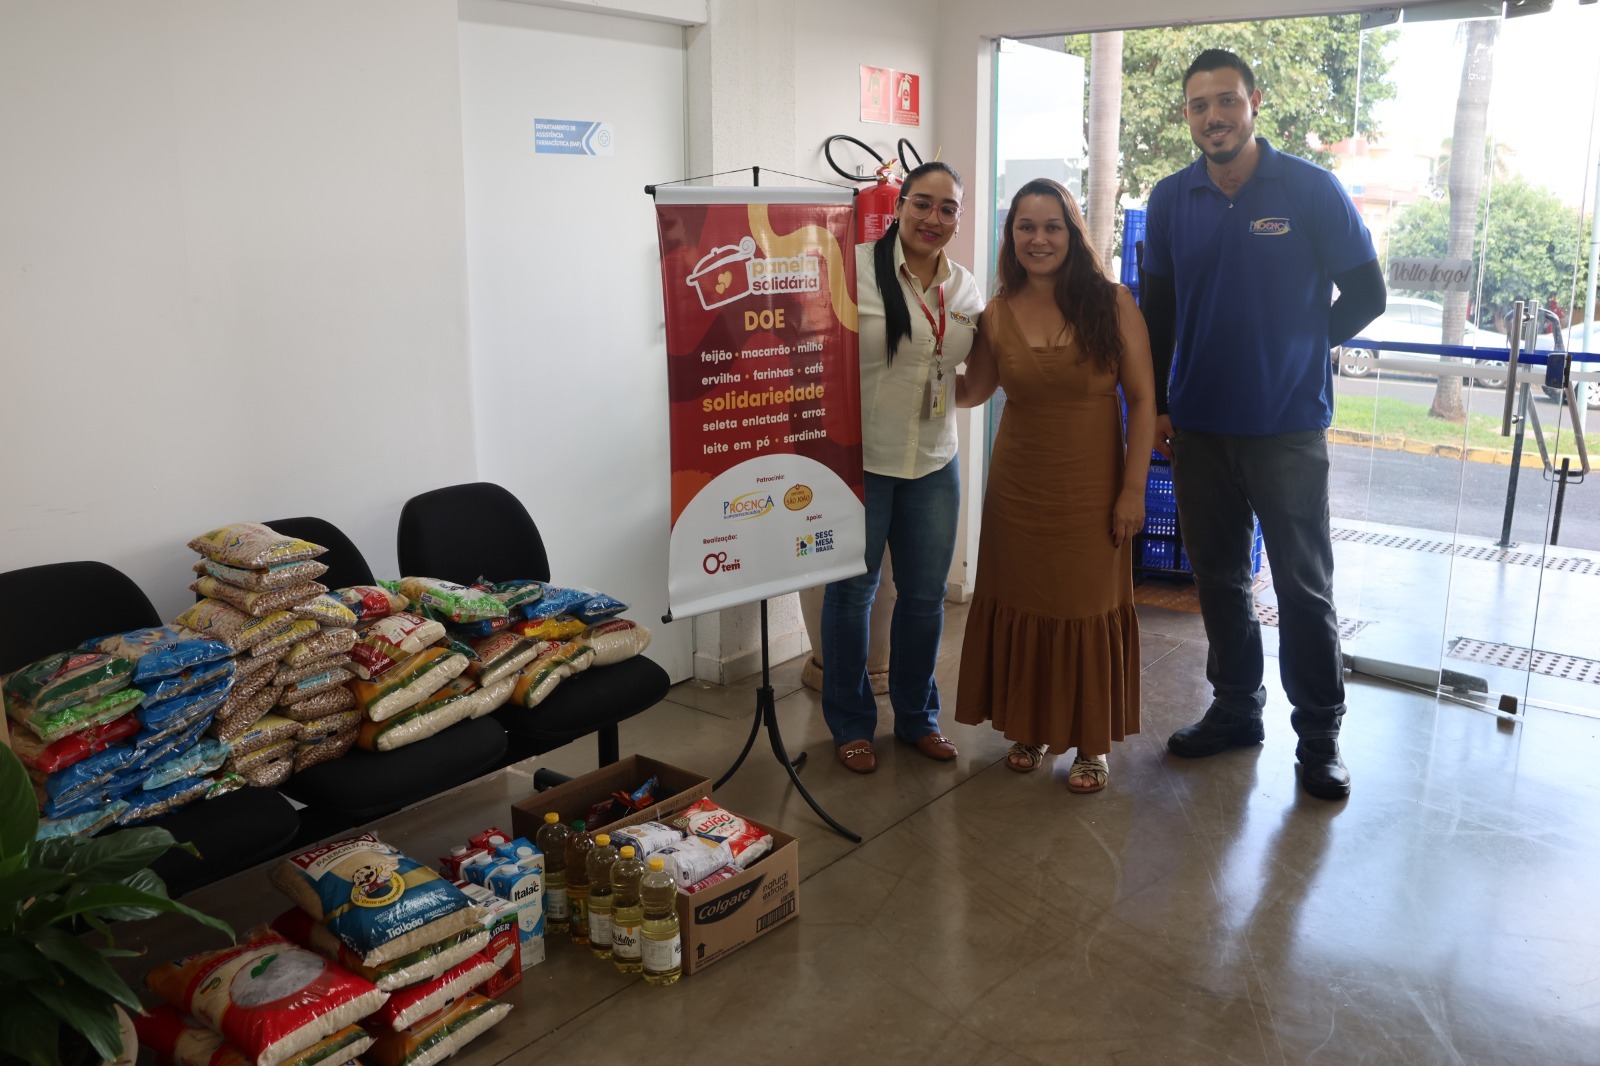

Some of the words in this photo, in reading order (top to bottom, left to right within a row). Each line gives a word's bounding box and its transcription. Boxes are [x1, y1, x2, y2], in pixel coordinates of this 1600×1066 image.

[752, 255, 817, 278] panela
[1430, 264, 1472, 290] logo!
[752, 275, 818, 291] solidária
[744, 308, 786, 331] DOE
[701, 350, 733, 365] feijão
[741, 344, 791, 360] macarrão
[797, 341, 824, 354] milho
[701, 372, 741, 386] ervilha
[753, 368, 794, 381] farinhas
[804, 362, 824, 375] café
[702, 383, 825, 413] solidariedade
[702, 418, 738, 432] seleta
[742, 412, 790, 428] enlatada
[801, 408, 826, 420] arroz
[703, 442, 729, 455] leite
[733, 441, 752, 451] em
[756, 435, 771, 451] pó
[783, 428, 827, 445] sardinha
[723, 495, 775, 515] PROENÇA
[703, 534, 738, 545] Realização:
[815, 529, 834, 540] SESC
[815, 538, 834, 547] MESA
[815, 545, 835, 553] BRASIL
[514, 884, 540, 901] Italac
[762, 870, 789, 893] natural
[762, 880, 789, 901] extracts
[698, 888, 751, 920] Colgate
